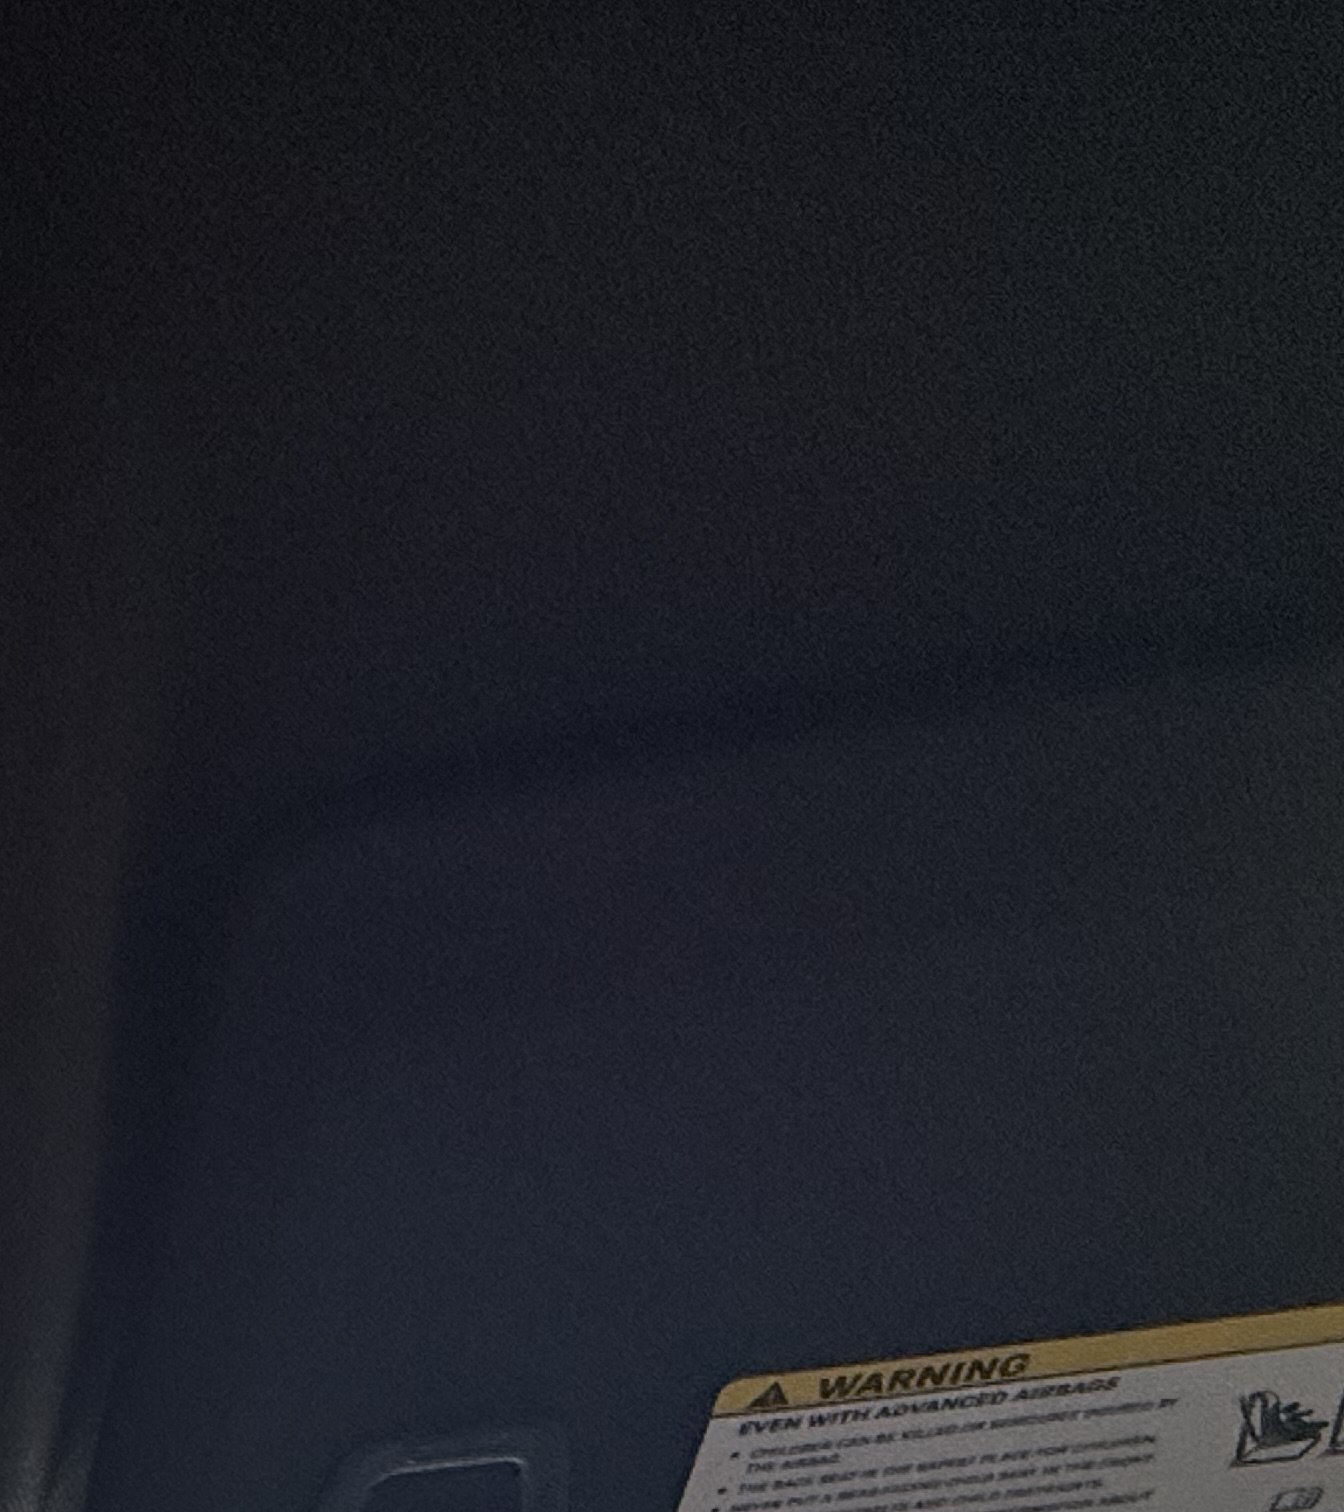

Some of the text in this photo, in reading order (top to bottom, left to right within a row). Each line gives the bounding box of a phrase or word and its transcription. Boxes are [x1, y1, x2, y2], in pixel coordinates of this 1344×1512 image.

[819, 1353, 1030, 1399] WARNING
[738, 1418, 802, 1435] EVEN
[808, 1409, 871, 1428] WITH
[873, 1389, 1009, 1418] ADVANCED
